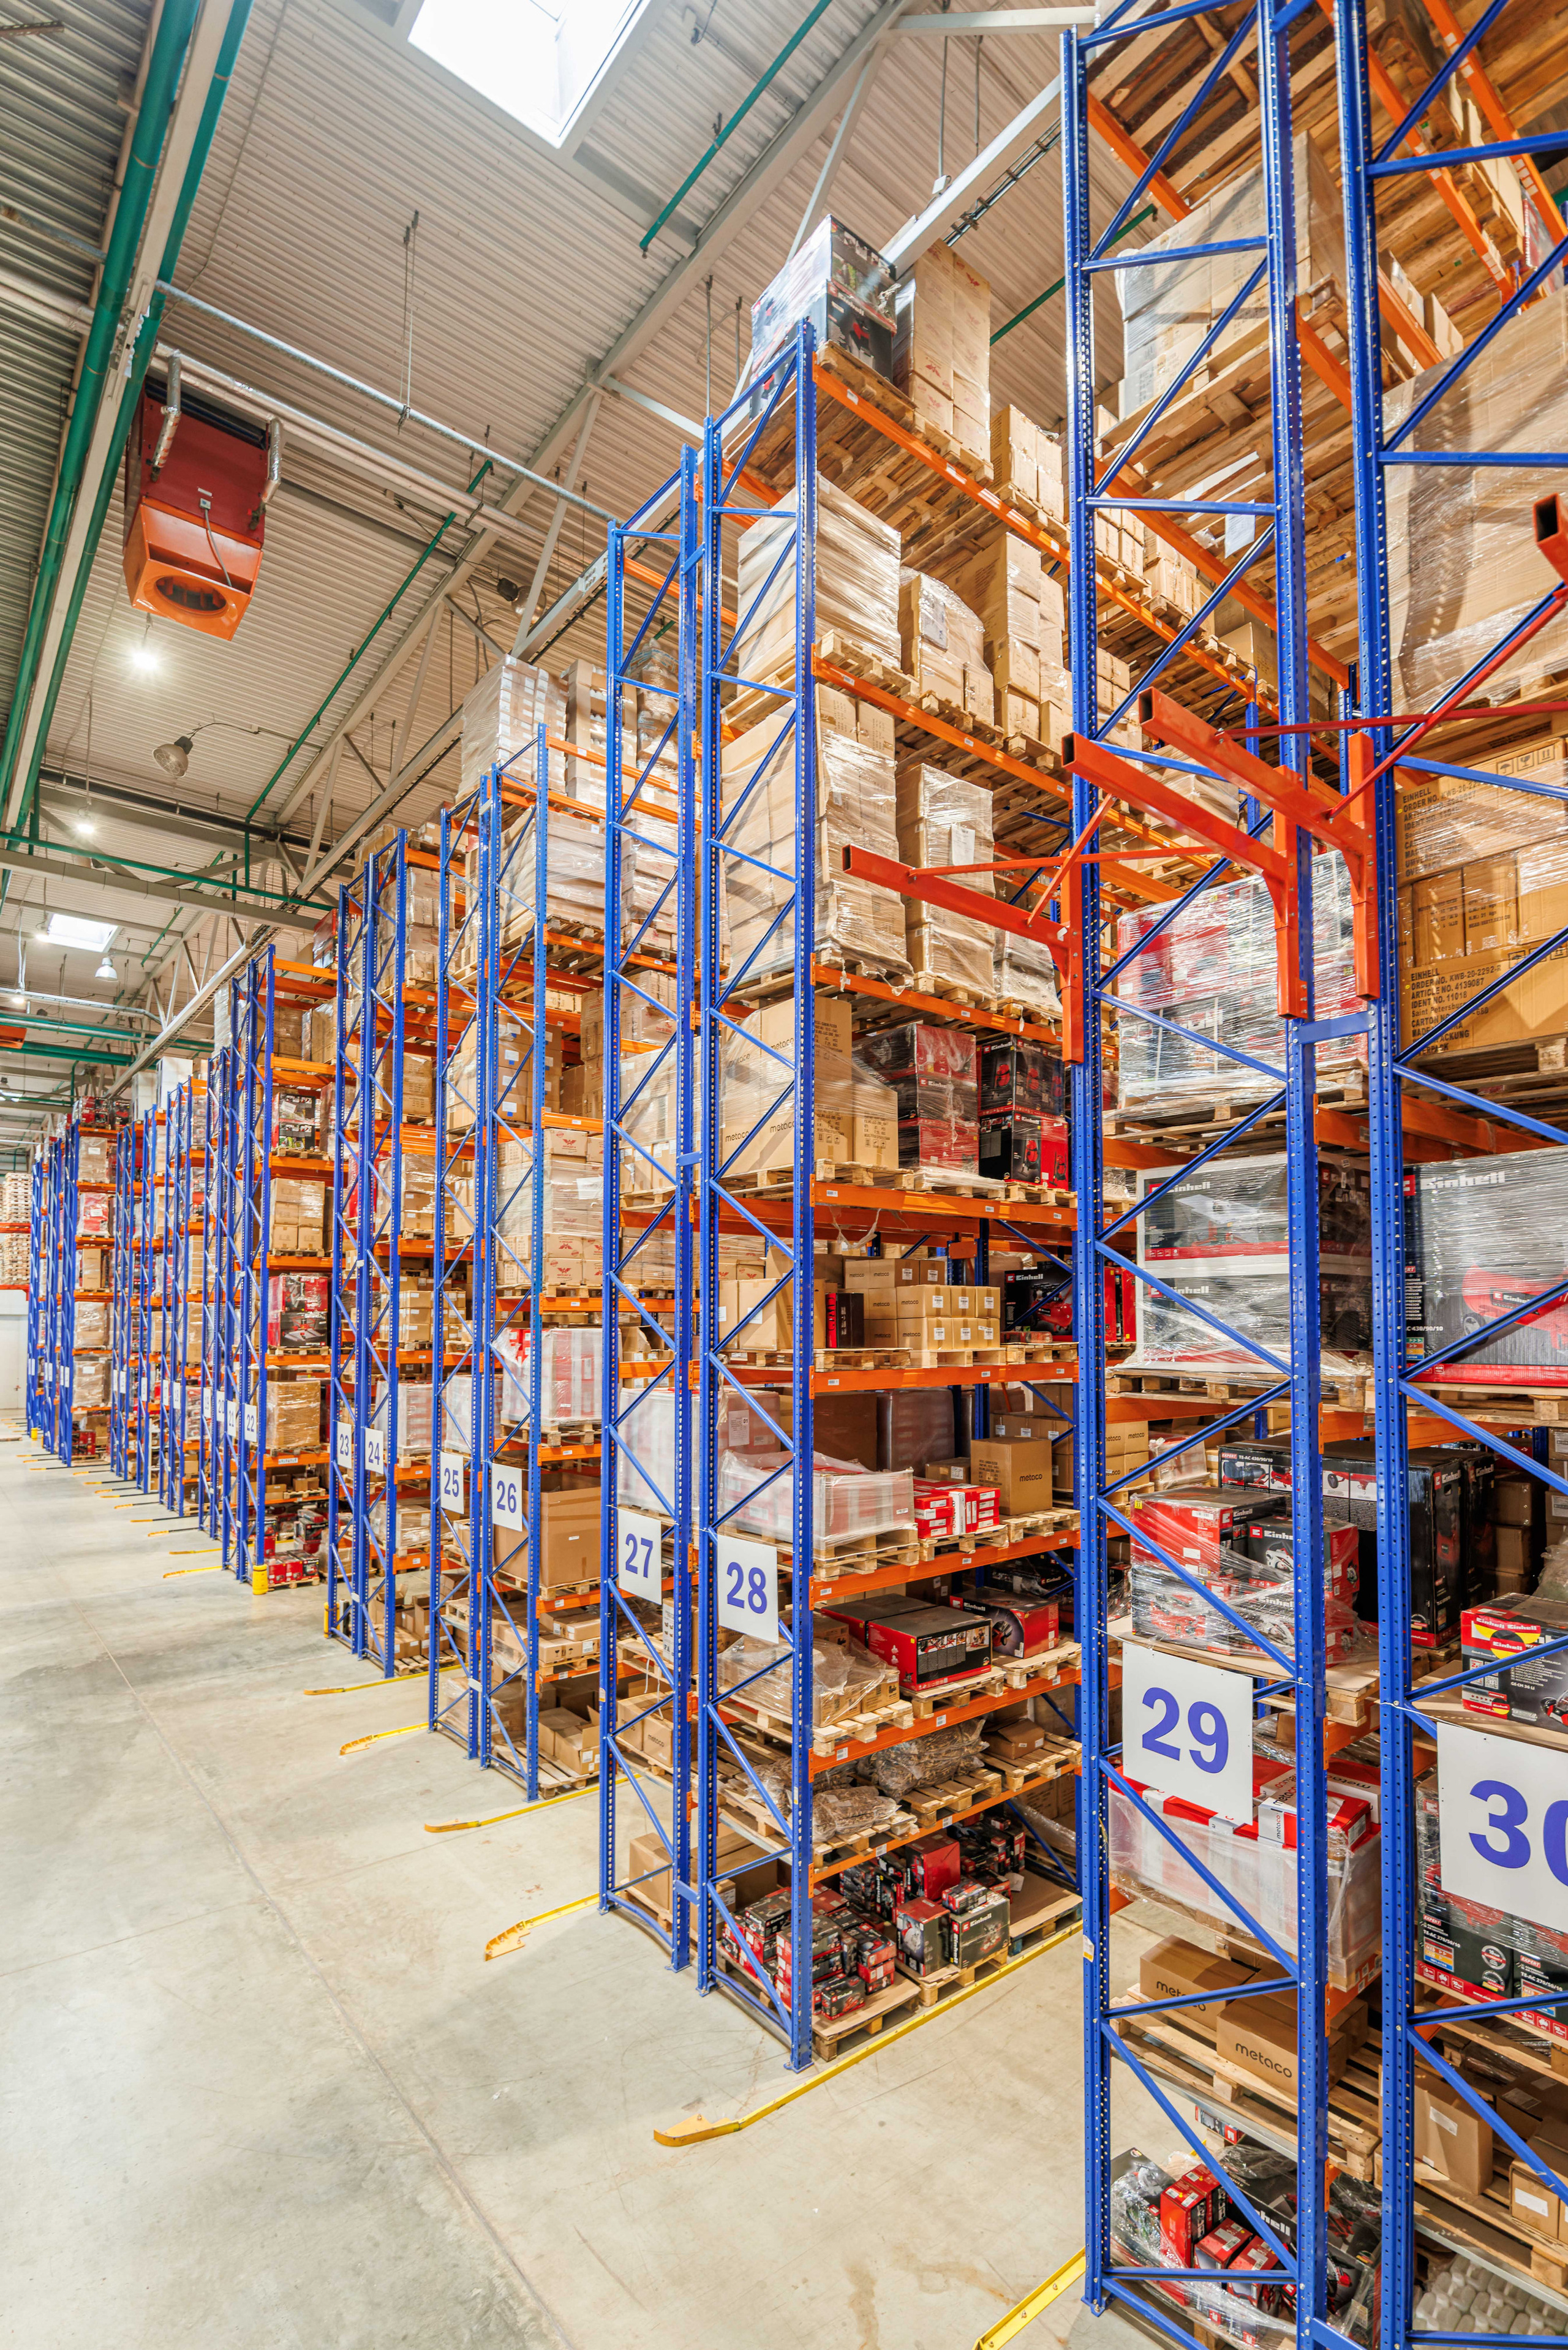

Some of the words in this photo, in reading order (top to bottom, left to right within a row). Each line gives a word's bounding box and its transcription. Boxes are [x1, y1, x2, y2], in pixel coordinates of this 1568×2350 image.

[1403, 787, 1431, 803] EINHELL
[1403, 799, 1427, 813] ORDER
[1428, 796, 1439, 807] NO.
[1411, 968, 1439, 981] EINHELL
[1411, 979, 1434, 990] ORDER
[1436, 976, 1447, 985] NO.
[1411, 988, 1440, 1000] ARTICLE
[1441, 985, 1453, 993] NO.
[1455, 978, 1485, 991] 4139087
[1411, 998, 1431, 1009] IDENT
[1433, 995, 1446, 1004] NO.
[1447, 991, 1468, 1001] 11018
[1412, 1007, 1429, 1017] Saint
[1411, 1015, 1439, 1028] CARTON
[991, 1041, 1012, 1050] Einhell
[1021, 1116, 1039, 1124] Einhell
[1420, 1171, 1506, 1190] Einhell
[229, 1410, 234, 1427] 21
[247, 1414, 254, 1432] 22
[340, 1434, 349, 1456] 23
[369, 1441, 380, 1465] 24
[444, 1467, 459, 1497] 25
[1019, 1473, 1042, 1482] metaco
[497, 1480, 516, 1513] 26
[625, 1534, 653, 1578] 27
[726, 1562, 767, 1614] 28
[963, 1602, 986, 1611] Einhell
[1476, 1618, 1505, 1629] Einhell
[1493, 1641, 1523, 1651] Einhell
[1141, 1687, 1229, 1774] 29
[970, 1913, 992, 1927] Einhell
[1424, 1915, 1441, 1925] EXPERT
[1521, 1957, 1540, 1967] EXPERT
[1536, 1977, 1563, 1992] 270/50/10
[1156, 1981, 1206, 2012] meto
[1235, 2043, 1292, 2078] metaco
